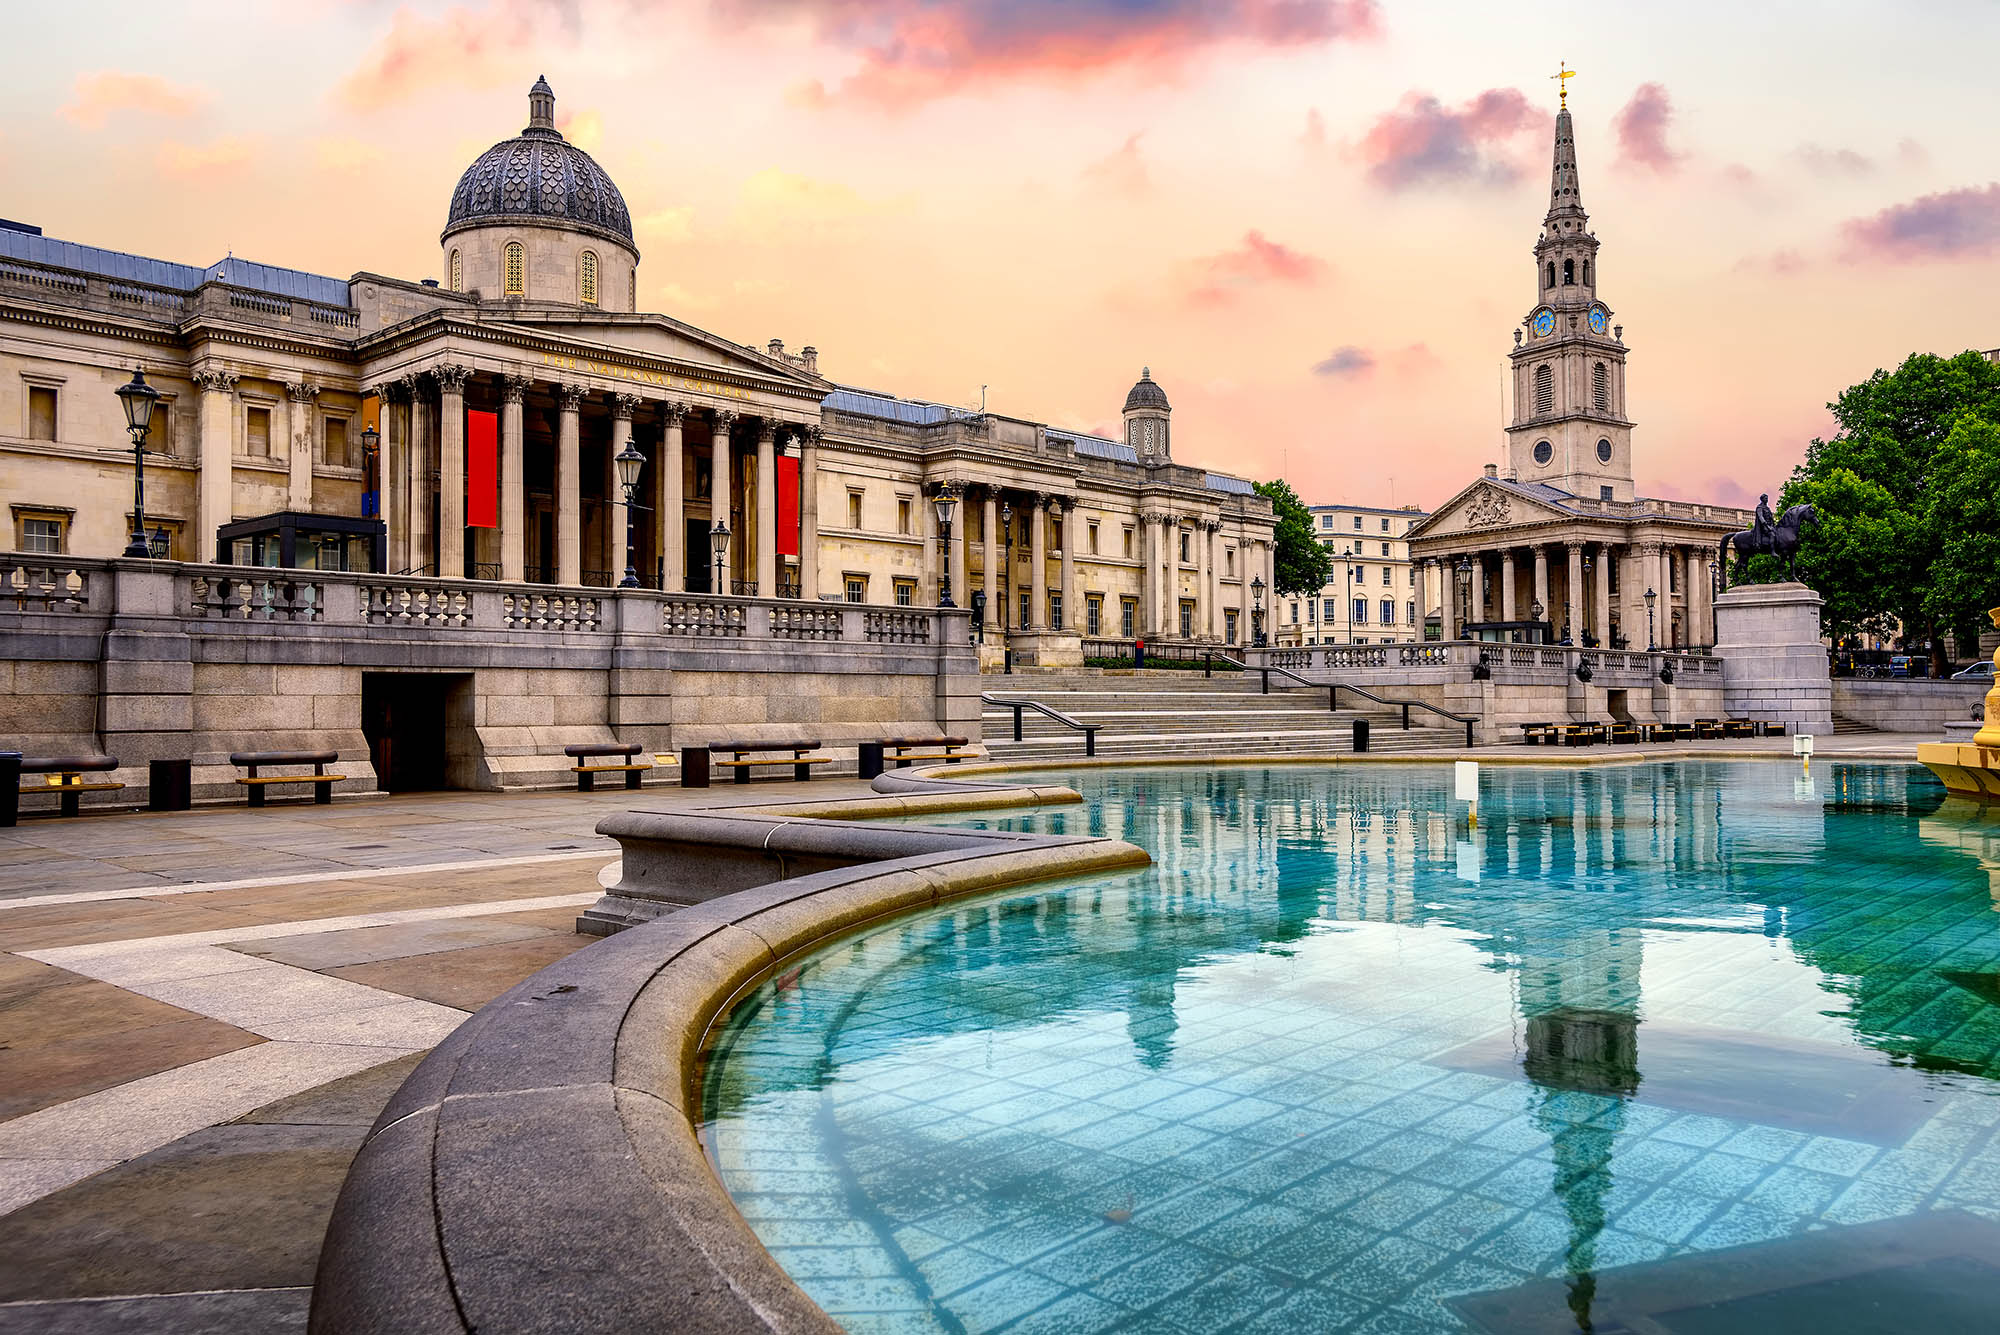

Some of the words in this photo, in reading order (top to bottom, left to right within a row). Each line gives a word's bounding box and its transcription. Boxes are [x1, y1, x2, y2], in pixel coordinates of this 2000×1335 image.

[542, 353, 575, 369] THE
[587, 361, 673, 387] NATIONAL
[684, 379, 752, 400] GALLERY
